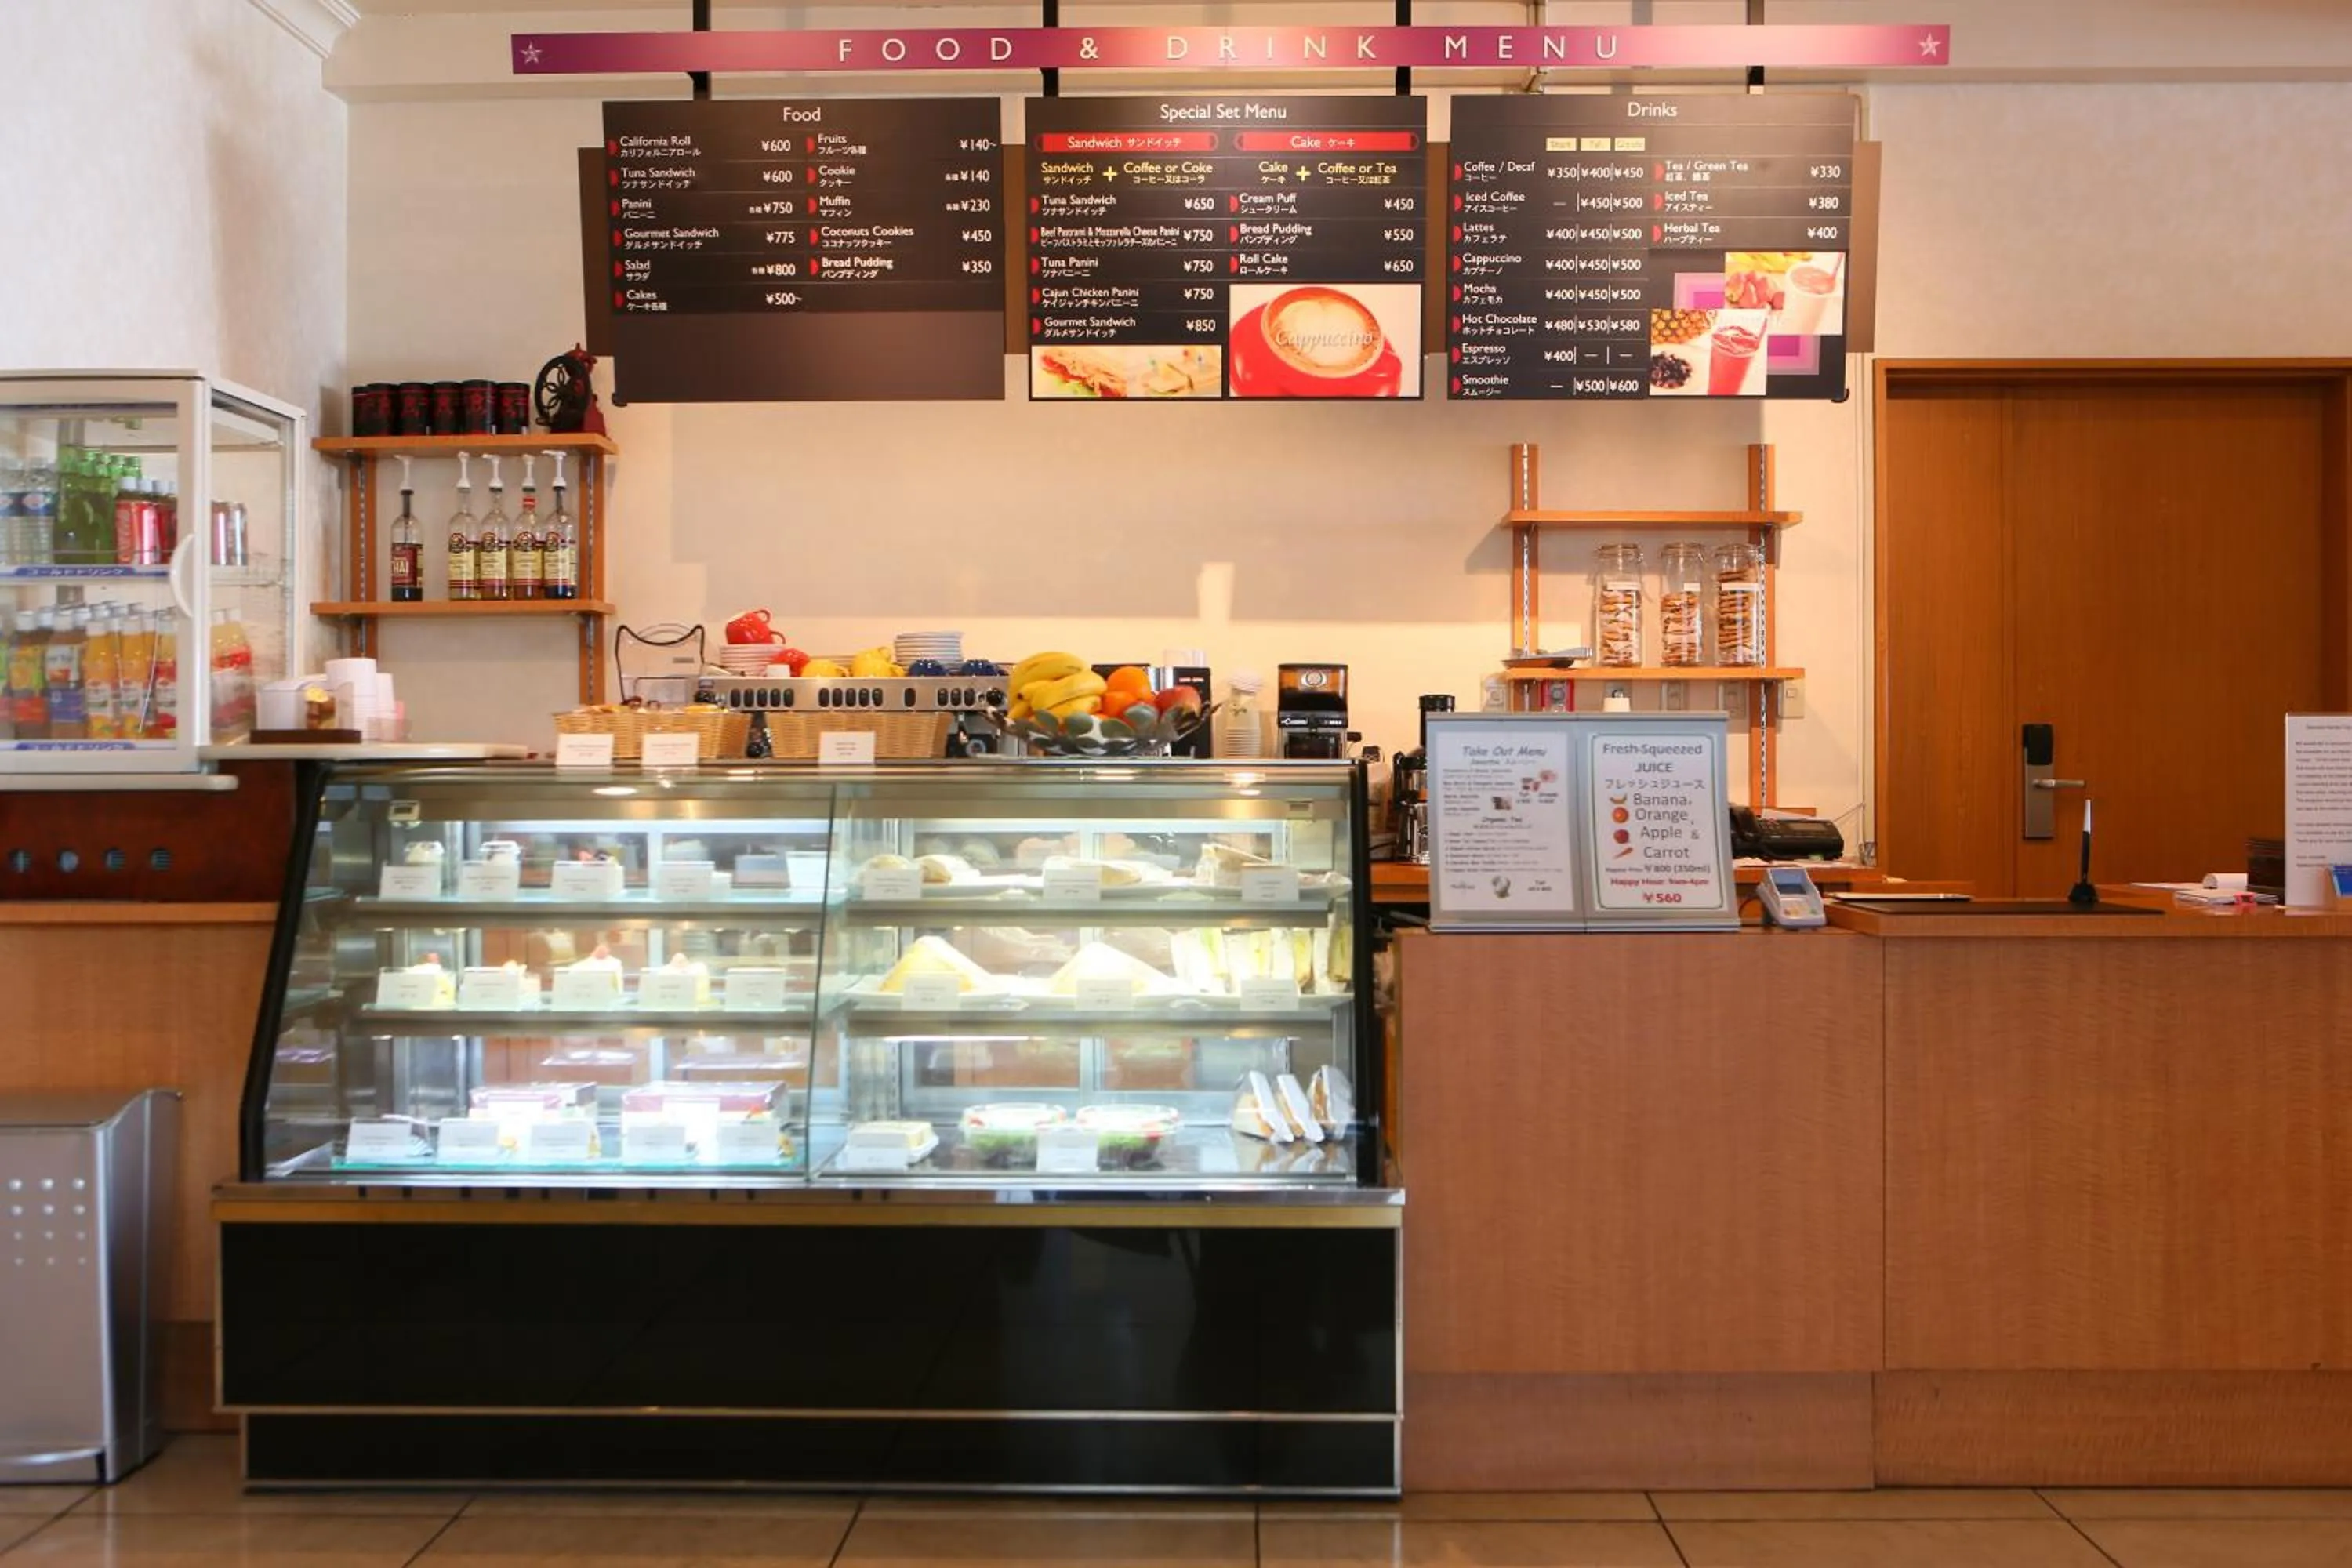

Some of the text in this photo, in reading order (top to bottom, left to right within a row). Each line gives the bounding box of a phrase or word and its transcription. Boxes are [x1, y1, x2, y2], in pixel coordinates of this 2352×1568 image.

[840, 35, 1617, 61] FOOD & DRINK MENU
[783, 107, 821, 122] Food
[1160, 103, 1287, 122] Special Set Menu
[1628, 102, 1677, 117] Drinks
[620, 136, 691, 147] California Roll
[818, 134, 847, 143] Fruits
[1068, 136, 1122, 148] Sandwich
[1290, 136, 1321, 148] Cake
[761, 140, 791, 151] ¥600
[818, 165, 855, 176] Cookie
[1041, 162, 1213, 173] Sandwich Coffee or Coke
[1258, 161, 1287, 173] Cake
[1318, 163, 1356, 173] Coffee
[1376, 163, 1397, 173] Tea
[1464, 161, 1536, 172] Coffee Decaf
[1665, 160, 1748, 171] Tea Green Tea
[621, 167, 695, 178] Tuna Sandwich
[763, 171, 793, 182] ¥600
[960, 170, 990, 182] ¥140
[1548, 167, 1577, 179] ¥350
[1581, 167, 1610, 179] ¥400
[1614, 167, 1644, 179] ¥450
[1810, 165, 1841, 179] ¥330
[819, 196, 851, 206] Muffin
[1042, 195, 1116, 205] Tuna Sandwich
[1240, 192, 1297, 203] Cream Puff
[1465, 191, 1525, 201] Iced Coffee
[1665, 191, 1708, 201] Iced Tea
[622, 198, 652, 209] Panini
[764, 202, 793, 214] ¥750
[960, 199, 990, 212] ¥230
[1185, 198, 1214, 210] ¥650
[1384, 198, 1414, 210] ¥450
[1581, 198, 1610, 209] ¥450
[1613, 197, 1642, 209] ¥500
[1809, 197, 1838, 209] ¥380
[624, 228, 719, 238] Gourmet Sandwich
[821, 226, 914, 236] Coconuts Cookies
[1240, 223, 1312, 236] Bread Pudding
[1463, 223, 1494, 232] Lattes
[1664, 223, 1720, 233] Herbal Tea
[1807, 227, 1837, 239] ¥400
[766, 232, 795, 244] ¥775
[962, 230, 992, 242] ¥450
[1184, 230, 1213, 241] ¥750
[1384, 229, 1414, 241] ¥550
[1546, 228, 1575, 239] ¥400
[1580, 228, 1608, 239] ¥450
[1613, 228, 1642, 239] ¥500
[822, 257, 893, 270] Bread Pudding
[1041, 257, 1098, 267] Tuna Panini
[1240, 254, 1287, 264] Roll Cake
[1462, 253, 1522, 264] Cappuccino
[625, 260, 650, 270] Salad
[767, 263, 796, 276] ¥800
[962, 261, 992, 273] ¥350
[1184, 260, 1214, 272] ¥750
[1384, 260, 1414, 272] ¥650
[1545, 259, 1574, 270] ¥400
[1578, 259, 1608, 270] ¥450
[1612, 259, 1641, 270] ¥500
[1042, 287, 1139, 299] Cajun Chicken Panini
[1184, 288, 1214, 300] ¥750
[1464, 284, 1497, 294] Mocha
[1545, 289, 1574, 300] ¥400
[1578, 289, 1608, 300] ¥450
[1612, 289, 1641, 300] ¥500
[626, 290, 657, 300] Cakes
[1044, 317, 1136, 327] Gourmet Sandwich
[1462, 314, 1537, 324] Hot Chocolate
[1186, 320, 1216, 332] ¥850
[1545, 320, 1573, 331] ¥480
[1578, 320, 1607, 331] ¥530
[1610, 319, 1640, 331] ¥580
[1462, 343, 1506, 354] Espresso
[1544, 351, 1573, 361] ¥400
[1462, 375, 1509, 385] Smoothie
[1576, 380, 1605, 391] ¥500
[1610, 380, 1639, 391] ¥600
[1463, 746, 1547, 757] Take Out Menu
[1603, 743, 1703, 757] Fresh-Squeezed
[1634, 762, 1673, 772] JUICE
[1641, 826, 1700, 840] Apple &
[1643, 846, 1690, 858] Carrot
